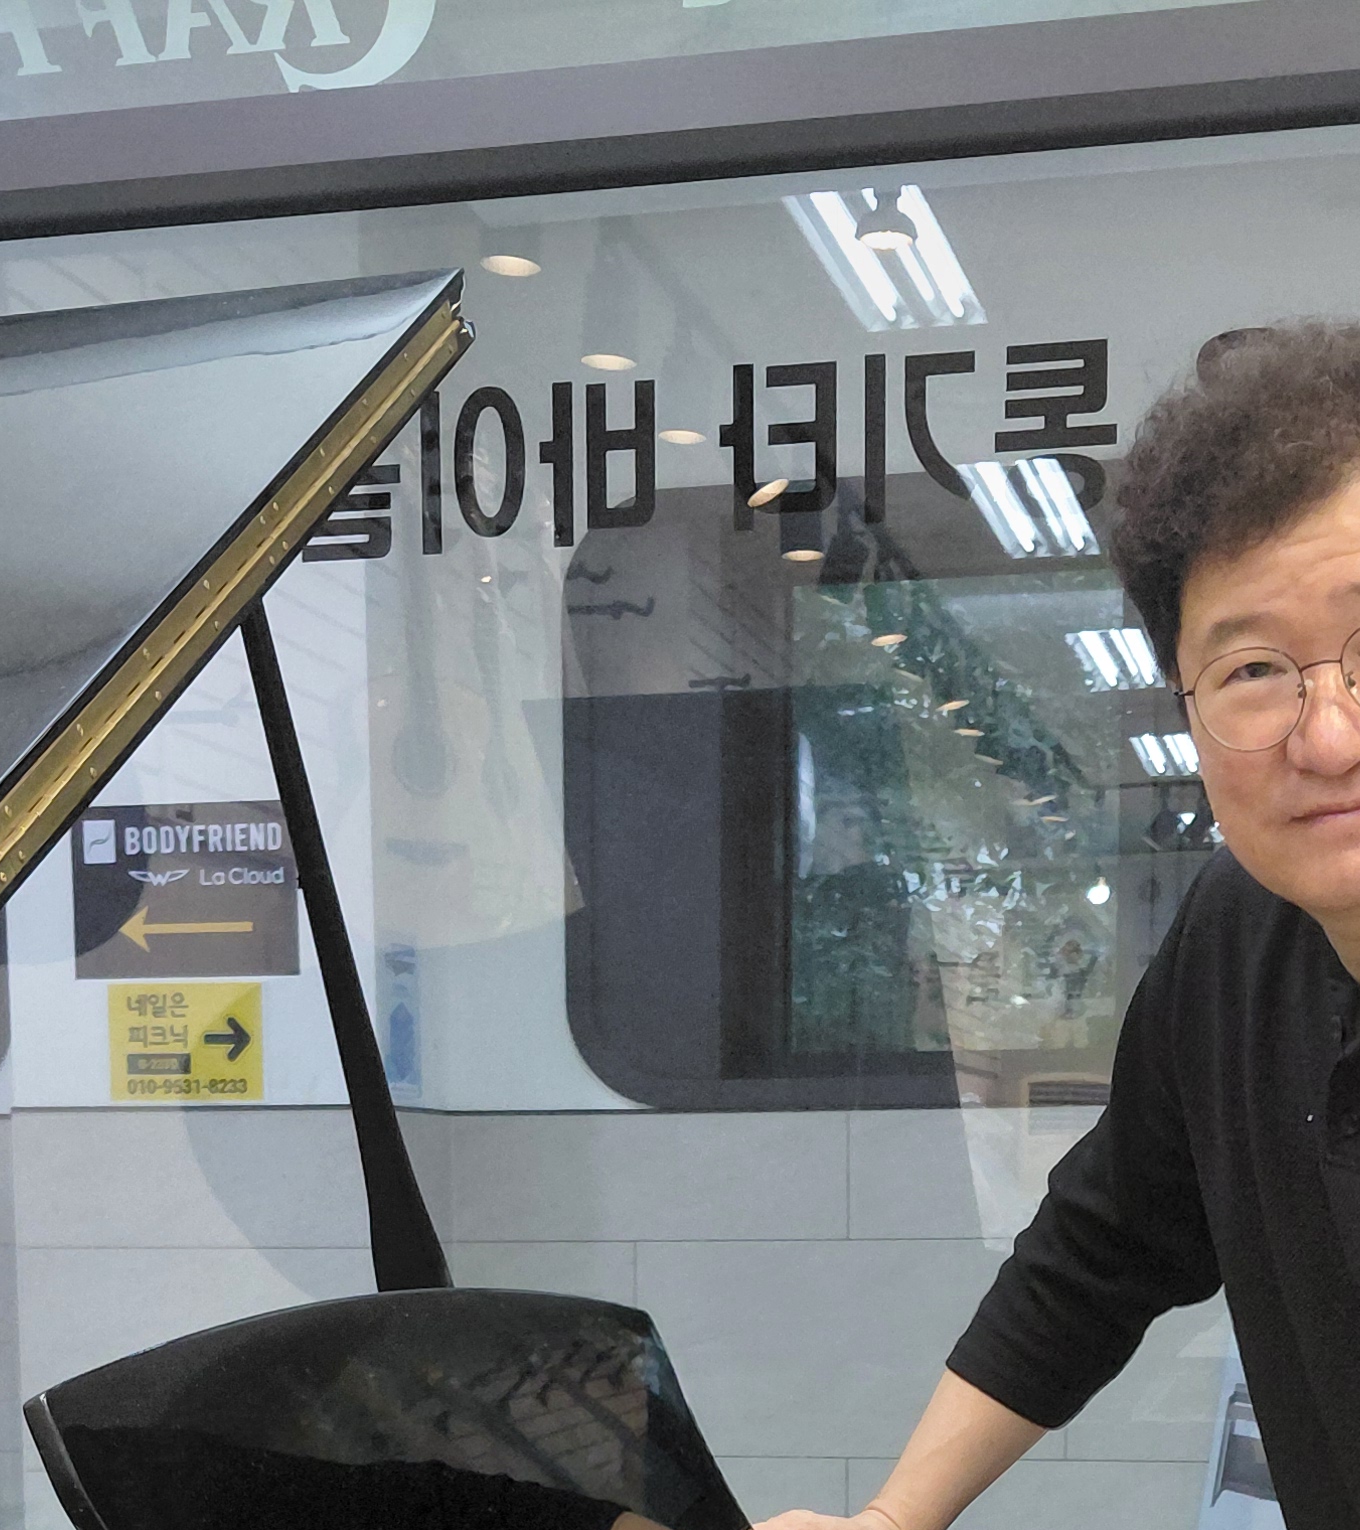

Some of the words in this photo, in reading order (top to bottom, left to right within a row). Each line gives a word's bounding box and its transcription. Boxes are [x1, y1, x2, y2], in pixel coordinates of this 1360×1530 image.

[124, 822, 283, 856] BODYFRIEND
[199, 869, 226, 886] La
[228, 866, 285, 886] Cloud
[126, 992, 189, 1018] 네일은
[128, 1025, 189, 1048] 피크닉
